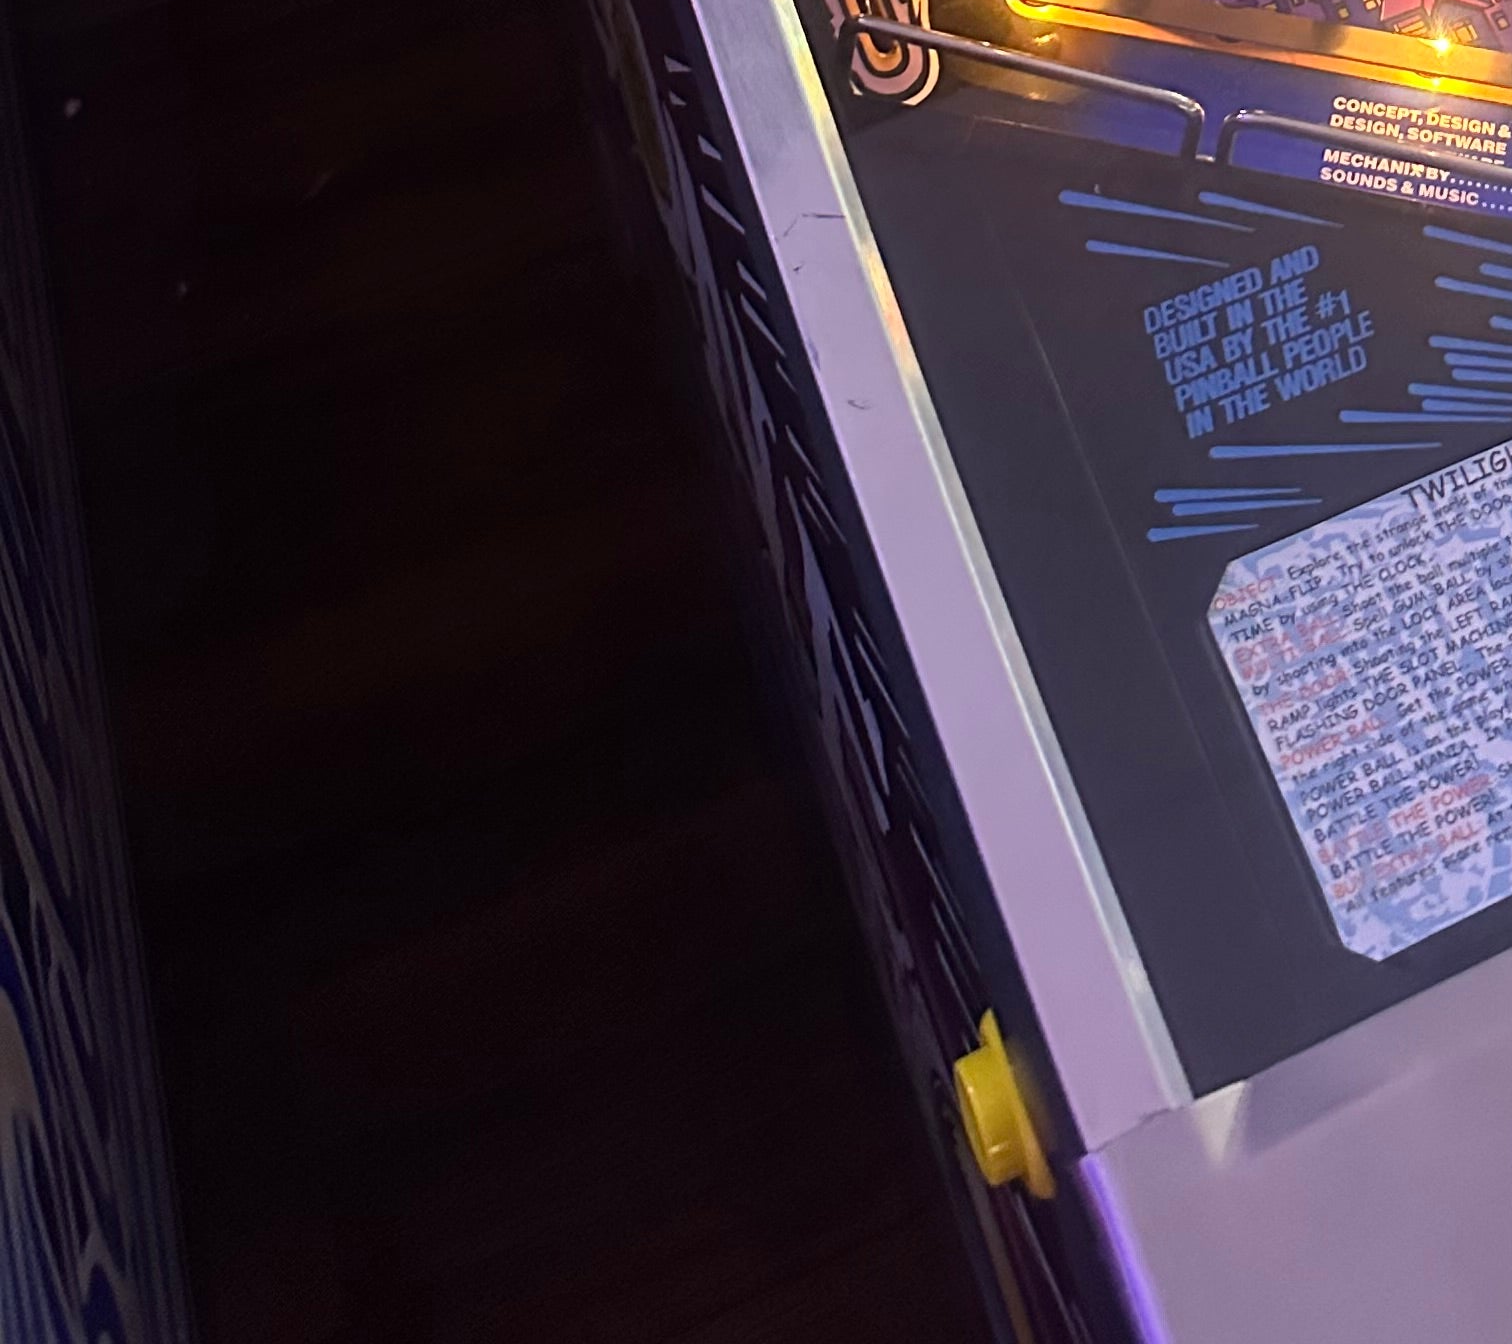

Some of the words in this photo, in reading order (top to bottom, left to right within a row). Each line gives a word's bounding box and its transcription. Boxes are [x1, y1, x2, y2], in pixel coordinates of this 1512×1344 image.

[1333, 96, 1424, 128] CONCEPT,
[1425, 107, 1495, 137] DESIGN
[1497, 124, 1512, 140] &
[1407, 126, 1508, 156] SOFTWARE
[1319, 166, 1399, 193] SOUNDS
[1401, 180, 1415, 196] &
[1418, 184, 1480, 207] MUSIC
[1323, 148, 1425, 178] MECHANIX
[1143, 265, 1264, 334] DESIGNED
[1269, 244, 1321, 286] AND
[1152, 313, 1217, 360] BUILT
[1226, 299, 1255, 329] IN
[1260, 278, 1309, 316] THE
[1164, 347, 1214, 387] USA
[1222, 331, 1254, 363] BY
[1262, 306, 1311, 345] THE
[1314, 288, 1352, 323] #1
[1173, 351, 1279, 413] PINBALL
[1283, 310, 1375, 372] PEOPLE
[1185, 408, 1213, 440] IN
[1219, 384, 1272, 424] THE
[1275, 344, 1368, 402] WORLD
[1230, 617, 1274, 647] TIME
[1276, 607, 1298, 628] by
[1340, 573, 1375, 598] THE
[1400, 603, 1442, 631] LOCK
[1444, 583, 1486, 611] AREA
[1312, 802, 1378, 845] BATTLE
[1381, 783, 1419, 812] THE
